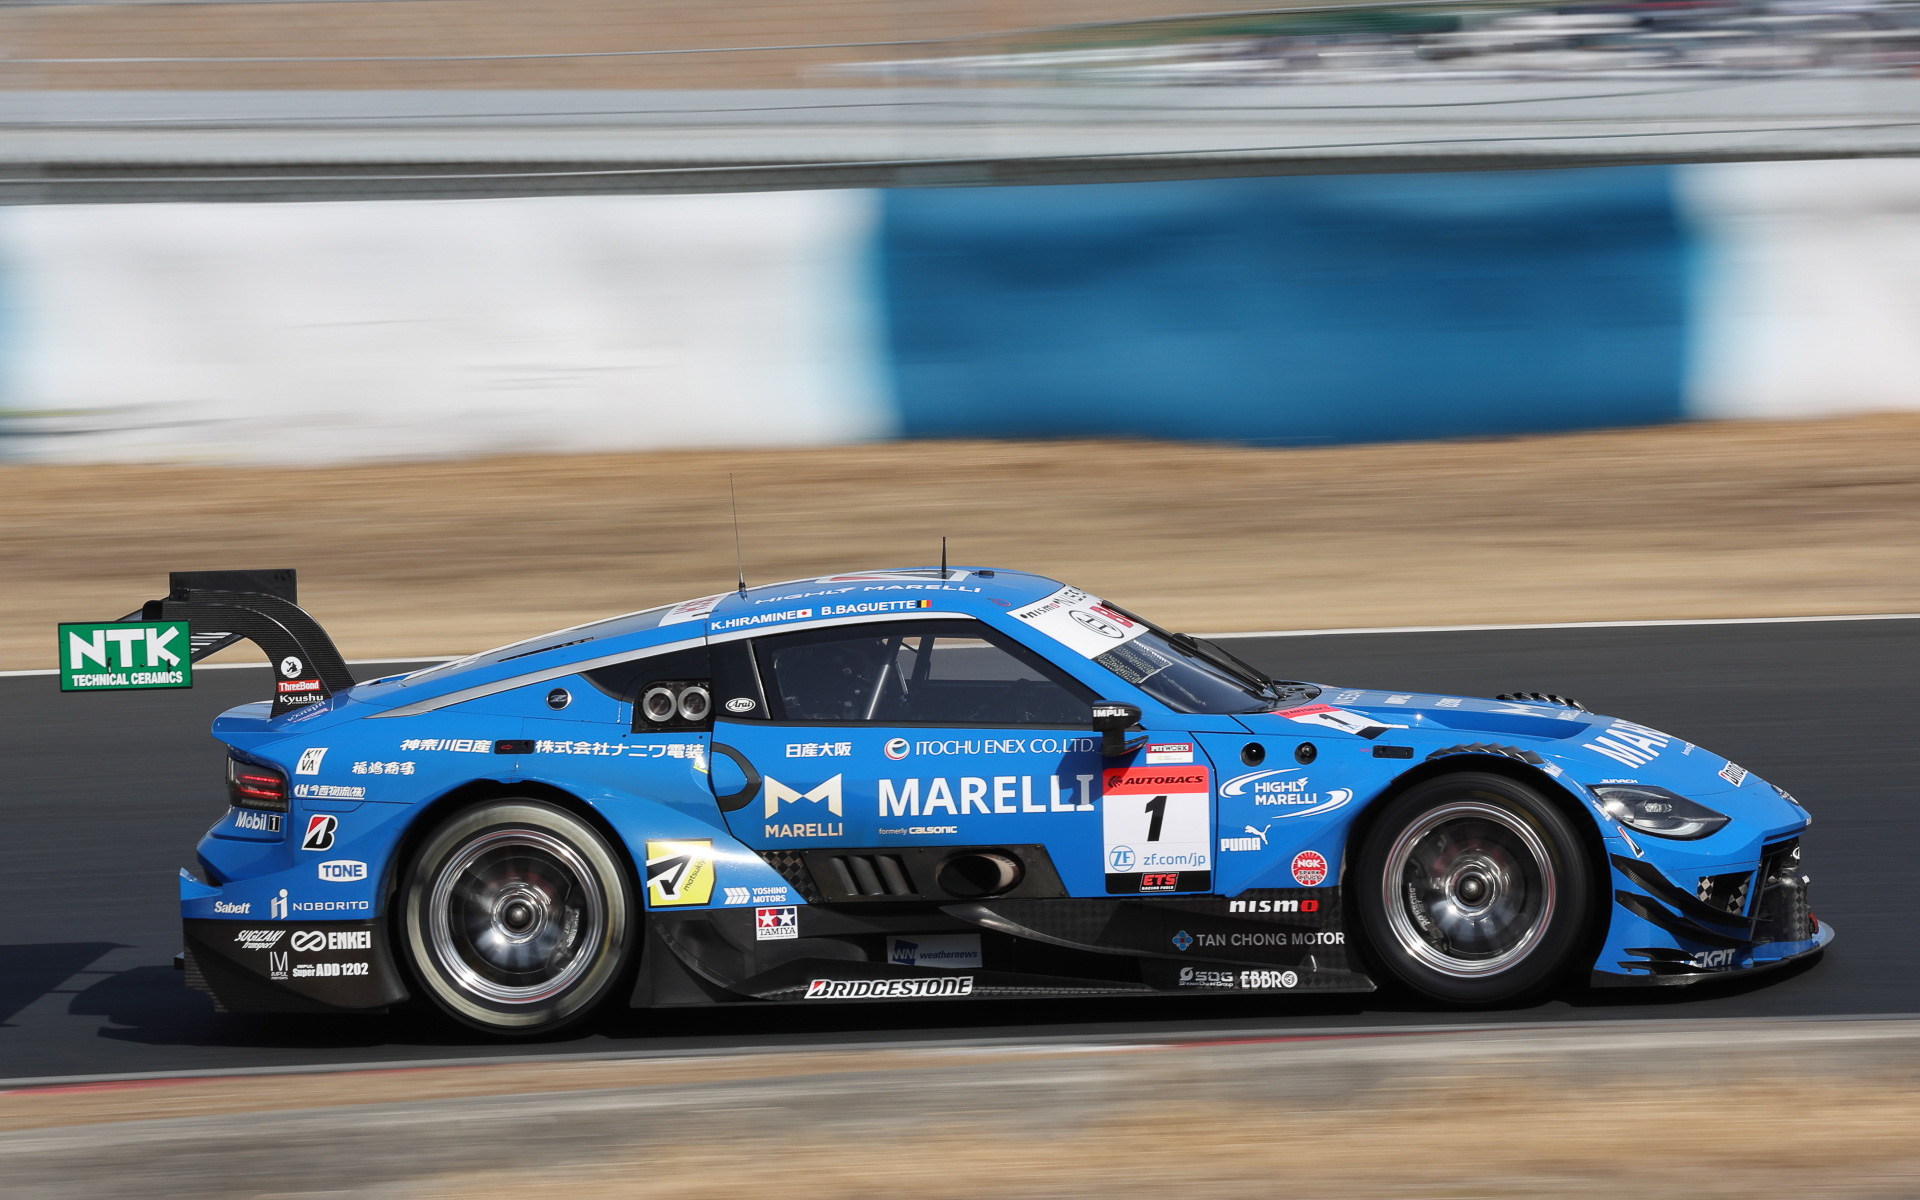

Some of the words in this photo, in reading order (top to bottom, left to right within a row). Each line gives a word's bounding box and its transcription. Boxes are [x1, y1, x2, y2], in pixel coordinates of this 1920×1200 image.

[863, 584, 982, 594] MARELLI
[821, 600, 917, 616] B.BAGUETTE
[711, 611, 797, 630] K.HIRAMINE
[69, 626, 181, 669] NTK
[72, 673, 129, 686] TECHNICAL
[131, 671, 183, 684] CERAMICS
[279, 681, 319, 691] ThreeBond
[280, 693, 323, 705] Kyushu
[1093, 708, 1128, 717] IMPUL
[400, 739, 491, 753] 神奈川日産
[786, 742, 851, 758] 日産大阪
[916, 741, 979, 755] ITOCHU
[985, 740, 1025, 754] ENEX
[1124, 775, 1204, 785] AUTOBACS
[1255, 777, 1308, 793] HIGHLY
[878, 774, 1094, 817] MARELLI
[1255, 793, 1317, 805] MARELLI
[235, 811, 266, 831] Mobil
[1144, 796, 1167, 842] 1
[765, 823, 843, 838] MARELLI
[879, 828, 907, 836] formerly
[1221, 838, 1261, 852] PUMA
[1143, 853, 1206, 867] zf.com/jp
[323, 865, 363, 877] TONE
[1143, 874, 1177, 885] ETS
[752, 887, 788, 895] YOSHINO
[293, 901, 369, 911] NOBORITO
[753, 895, 787, 903] MOTORS
[1229, 900, 1319, 912] nismo
[214, 901, 251, 914] Sabelt
[234, 930, 286, 941] SUGIZAKI
[758, 927, 796, 936] TAMIYA
[328, 931, 371, 950] ENKEI
[1197, 934, 1226, 946] TAN
[1230, 933, 1287, 945] CHONG
[1292, 932, 1345, 945] MOTOR
[920, 950, 978, 959] weathernews
[292, 967, 315, 978] Super
[315, 963, 340, 977] ADD
[341, 962, 369, 976] 1202
[1240, 970, 1298, 988] EBBRO
[806, 977, 972, 999] BRIDGESTONE
